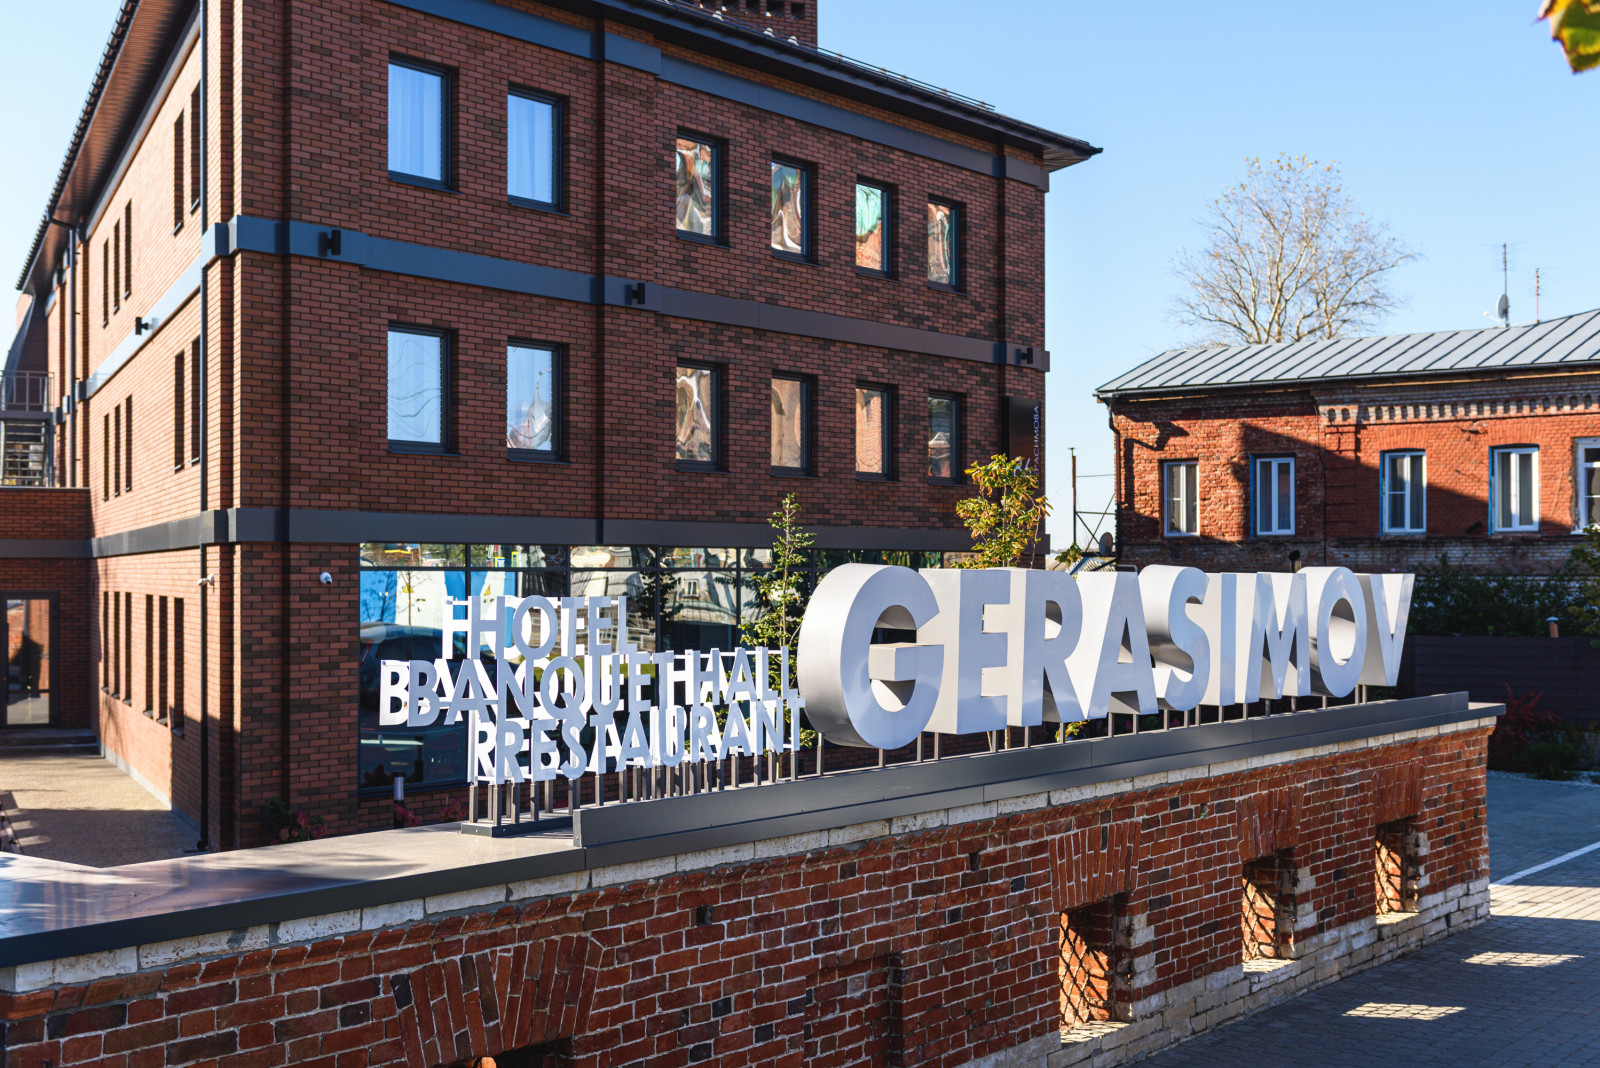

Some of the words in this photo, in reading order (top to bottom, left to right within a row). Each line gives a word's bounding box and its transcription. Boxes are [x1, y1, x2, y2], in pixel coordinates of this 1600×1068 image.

[469, 595, 638, 660] HOTEL
[806, 563, 1415, 750] GERASIMOV
[407, 651, 674, 727] BANQUET
[692, 645, 799, 706] HALL
[495, 697, 806, 785] RESTAURANT
